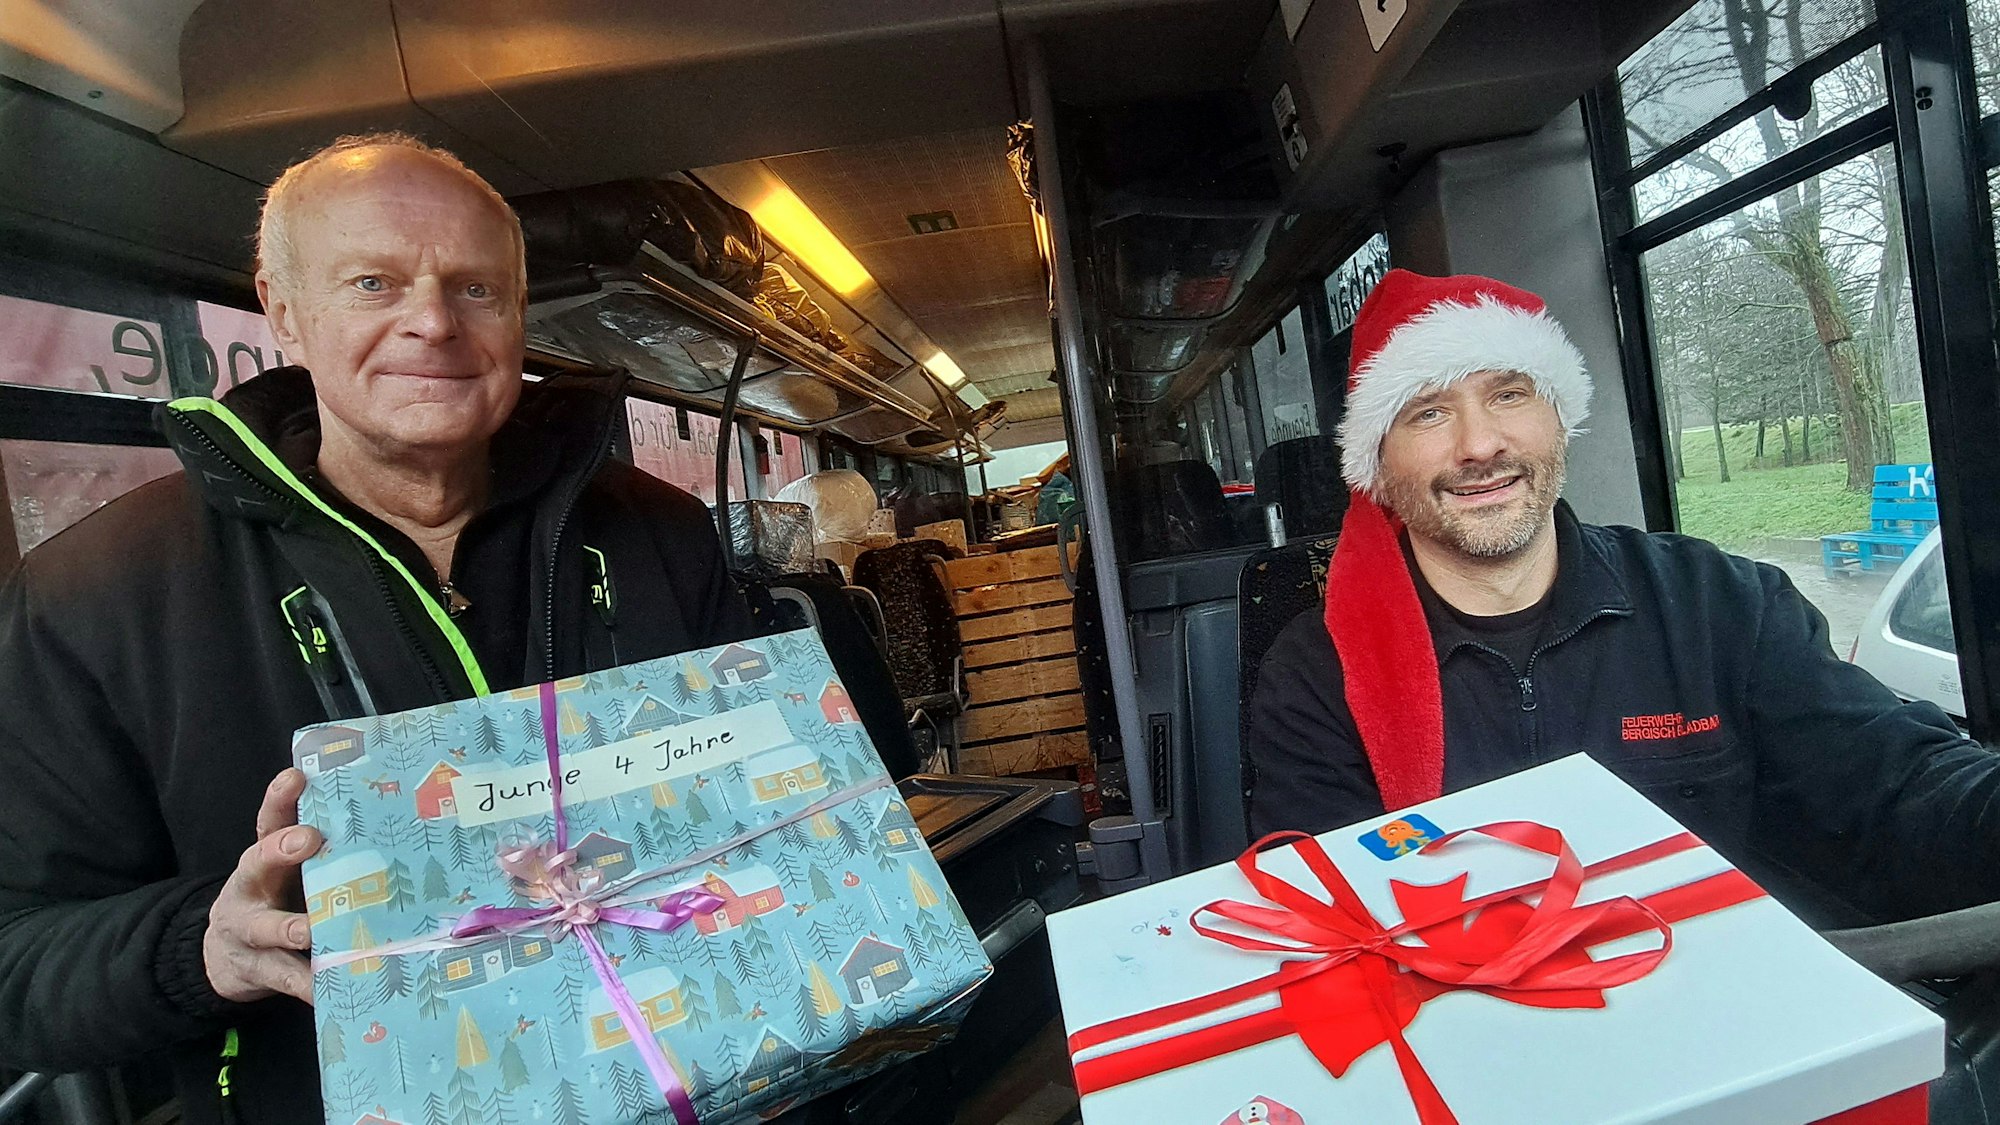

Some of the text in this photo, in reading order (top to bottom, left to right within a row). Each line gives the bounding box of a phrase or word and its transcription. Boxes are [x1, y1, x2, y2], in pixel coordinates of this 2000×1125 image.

[1622, 726, 1676, 740] BERGISCH
[615, 755, 634, 775] 4
[653, 730, 735, 771] Jahre
